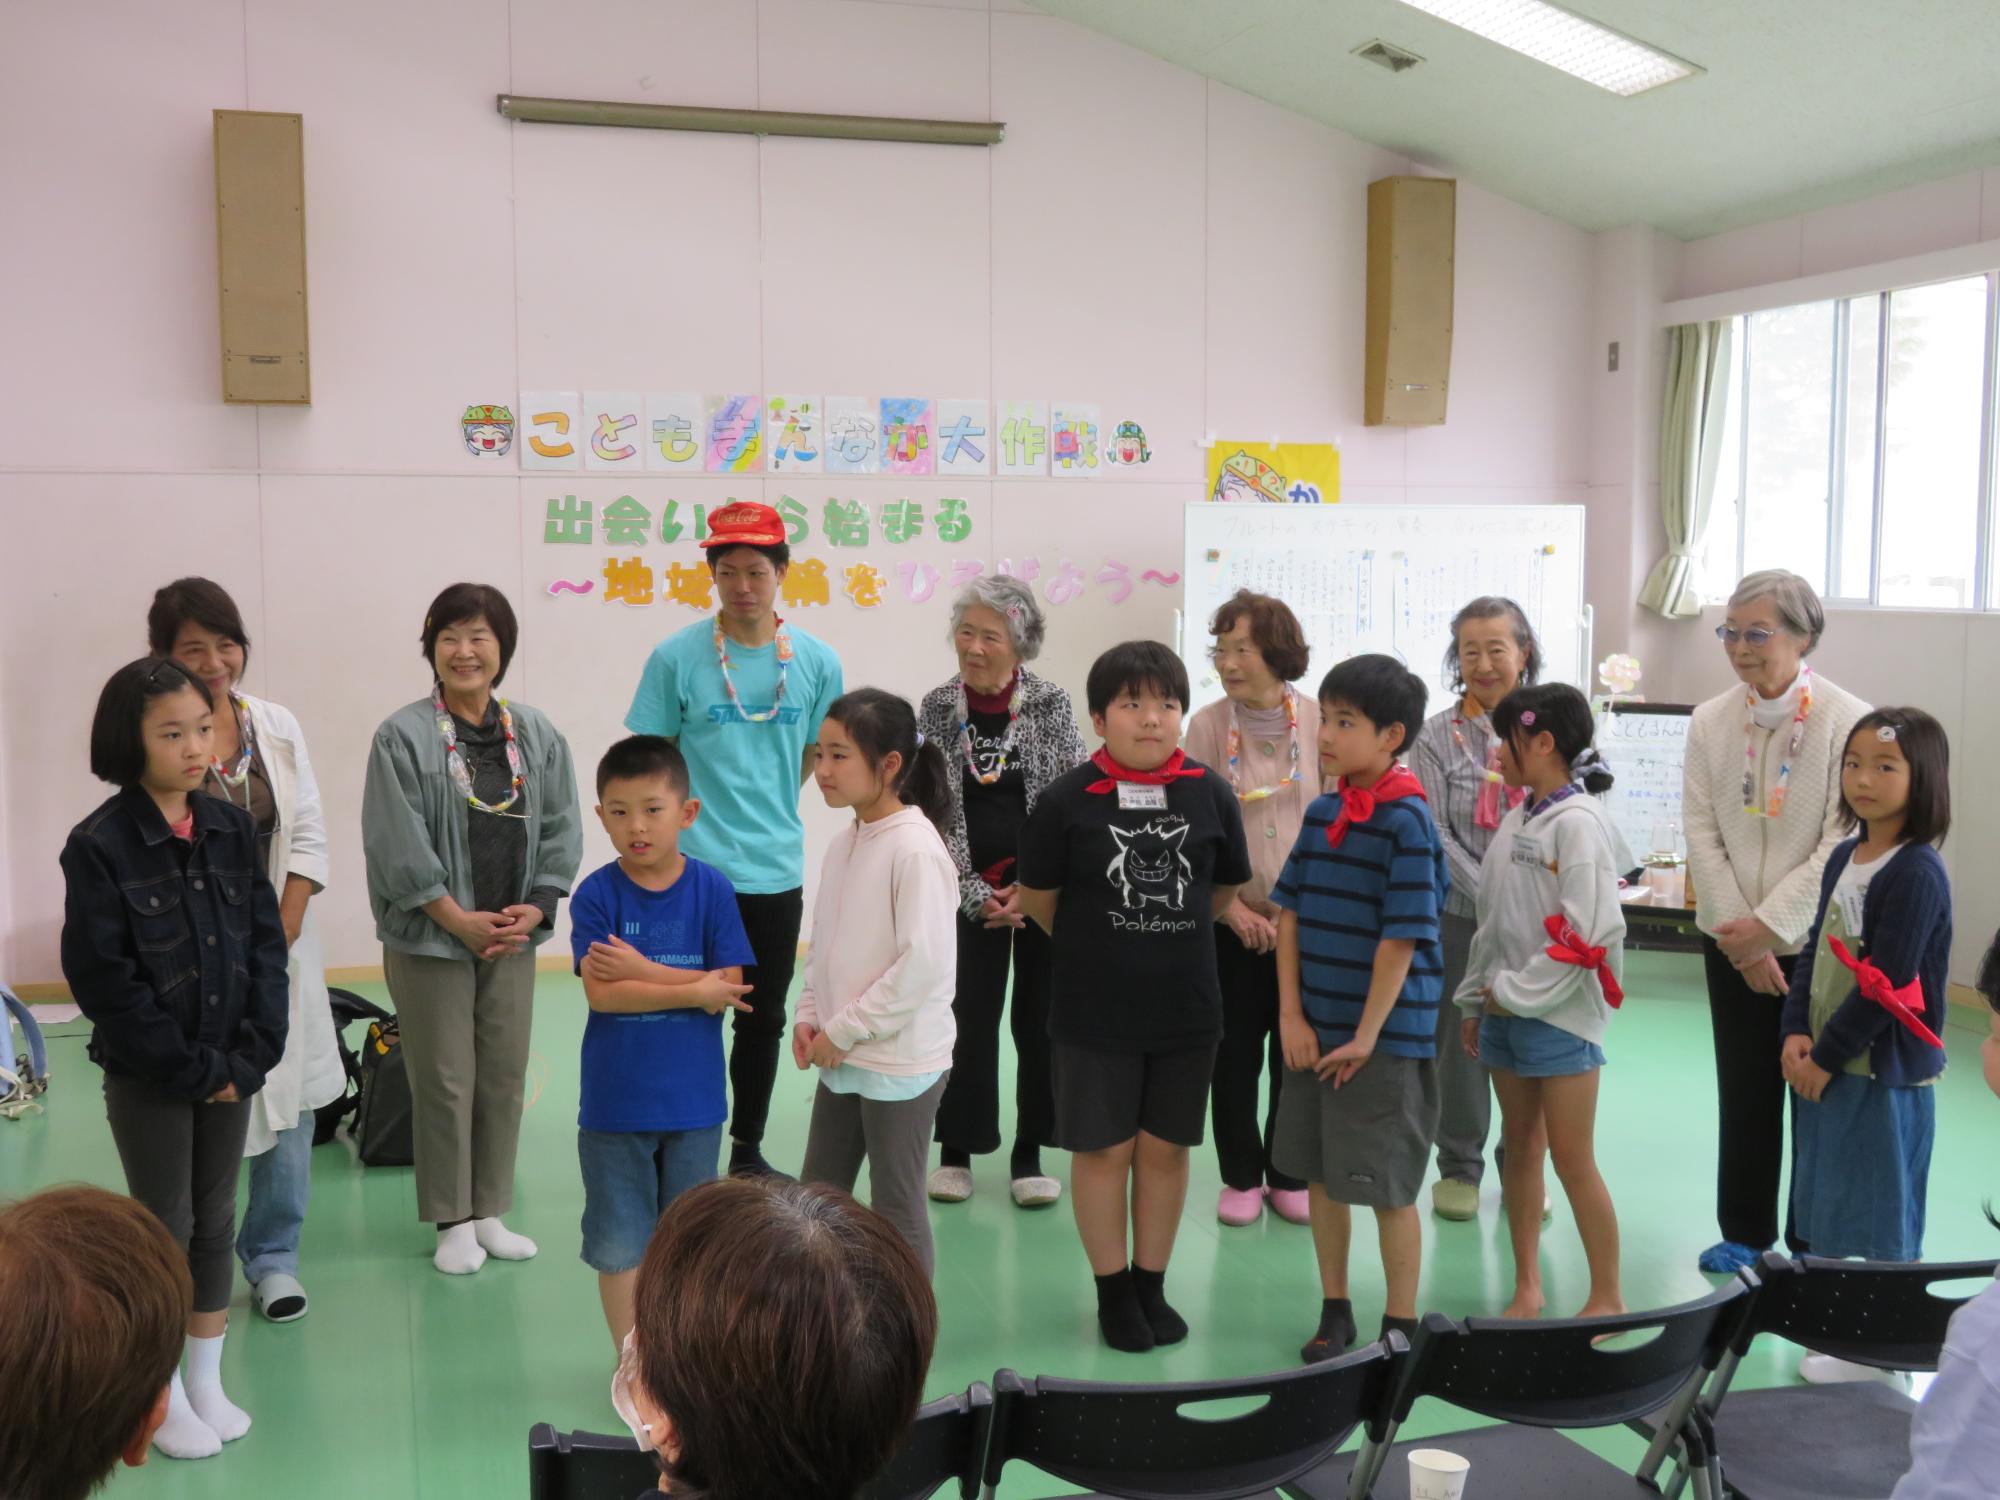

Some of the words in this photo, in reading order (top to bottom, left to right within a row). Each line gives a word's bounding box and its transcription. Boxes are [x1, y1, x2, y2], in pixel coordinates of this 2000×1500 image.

[543, 494, 973, 548] 出会いら始まる
[1107, 911, 1196, 933] Pokémon
